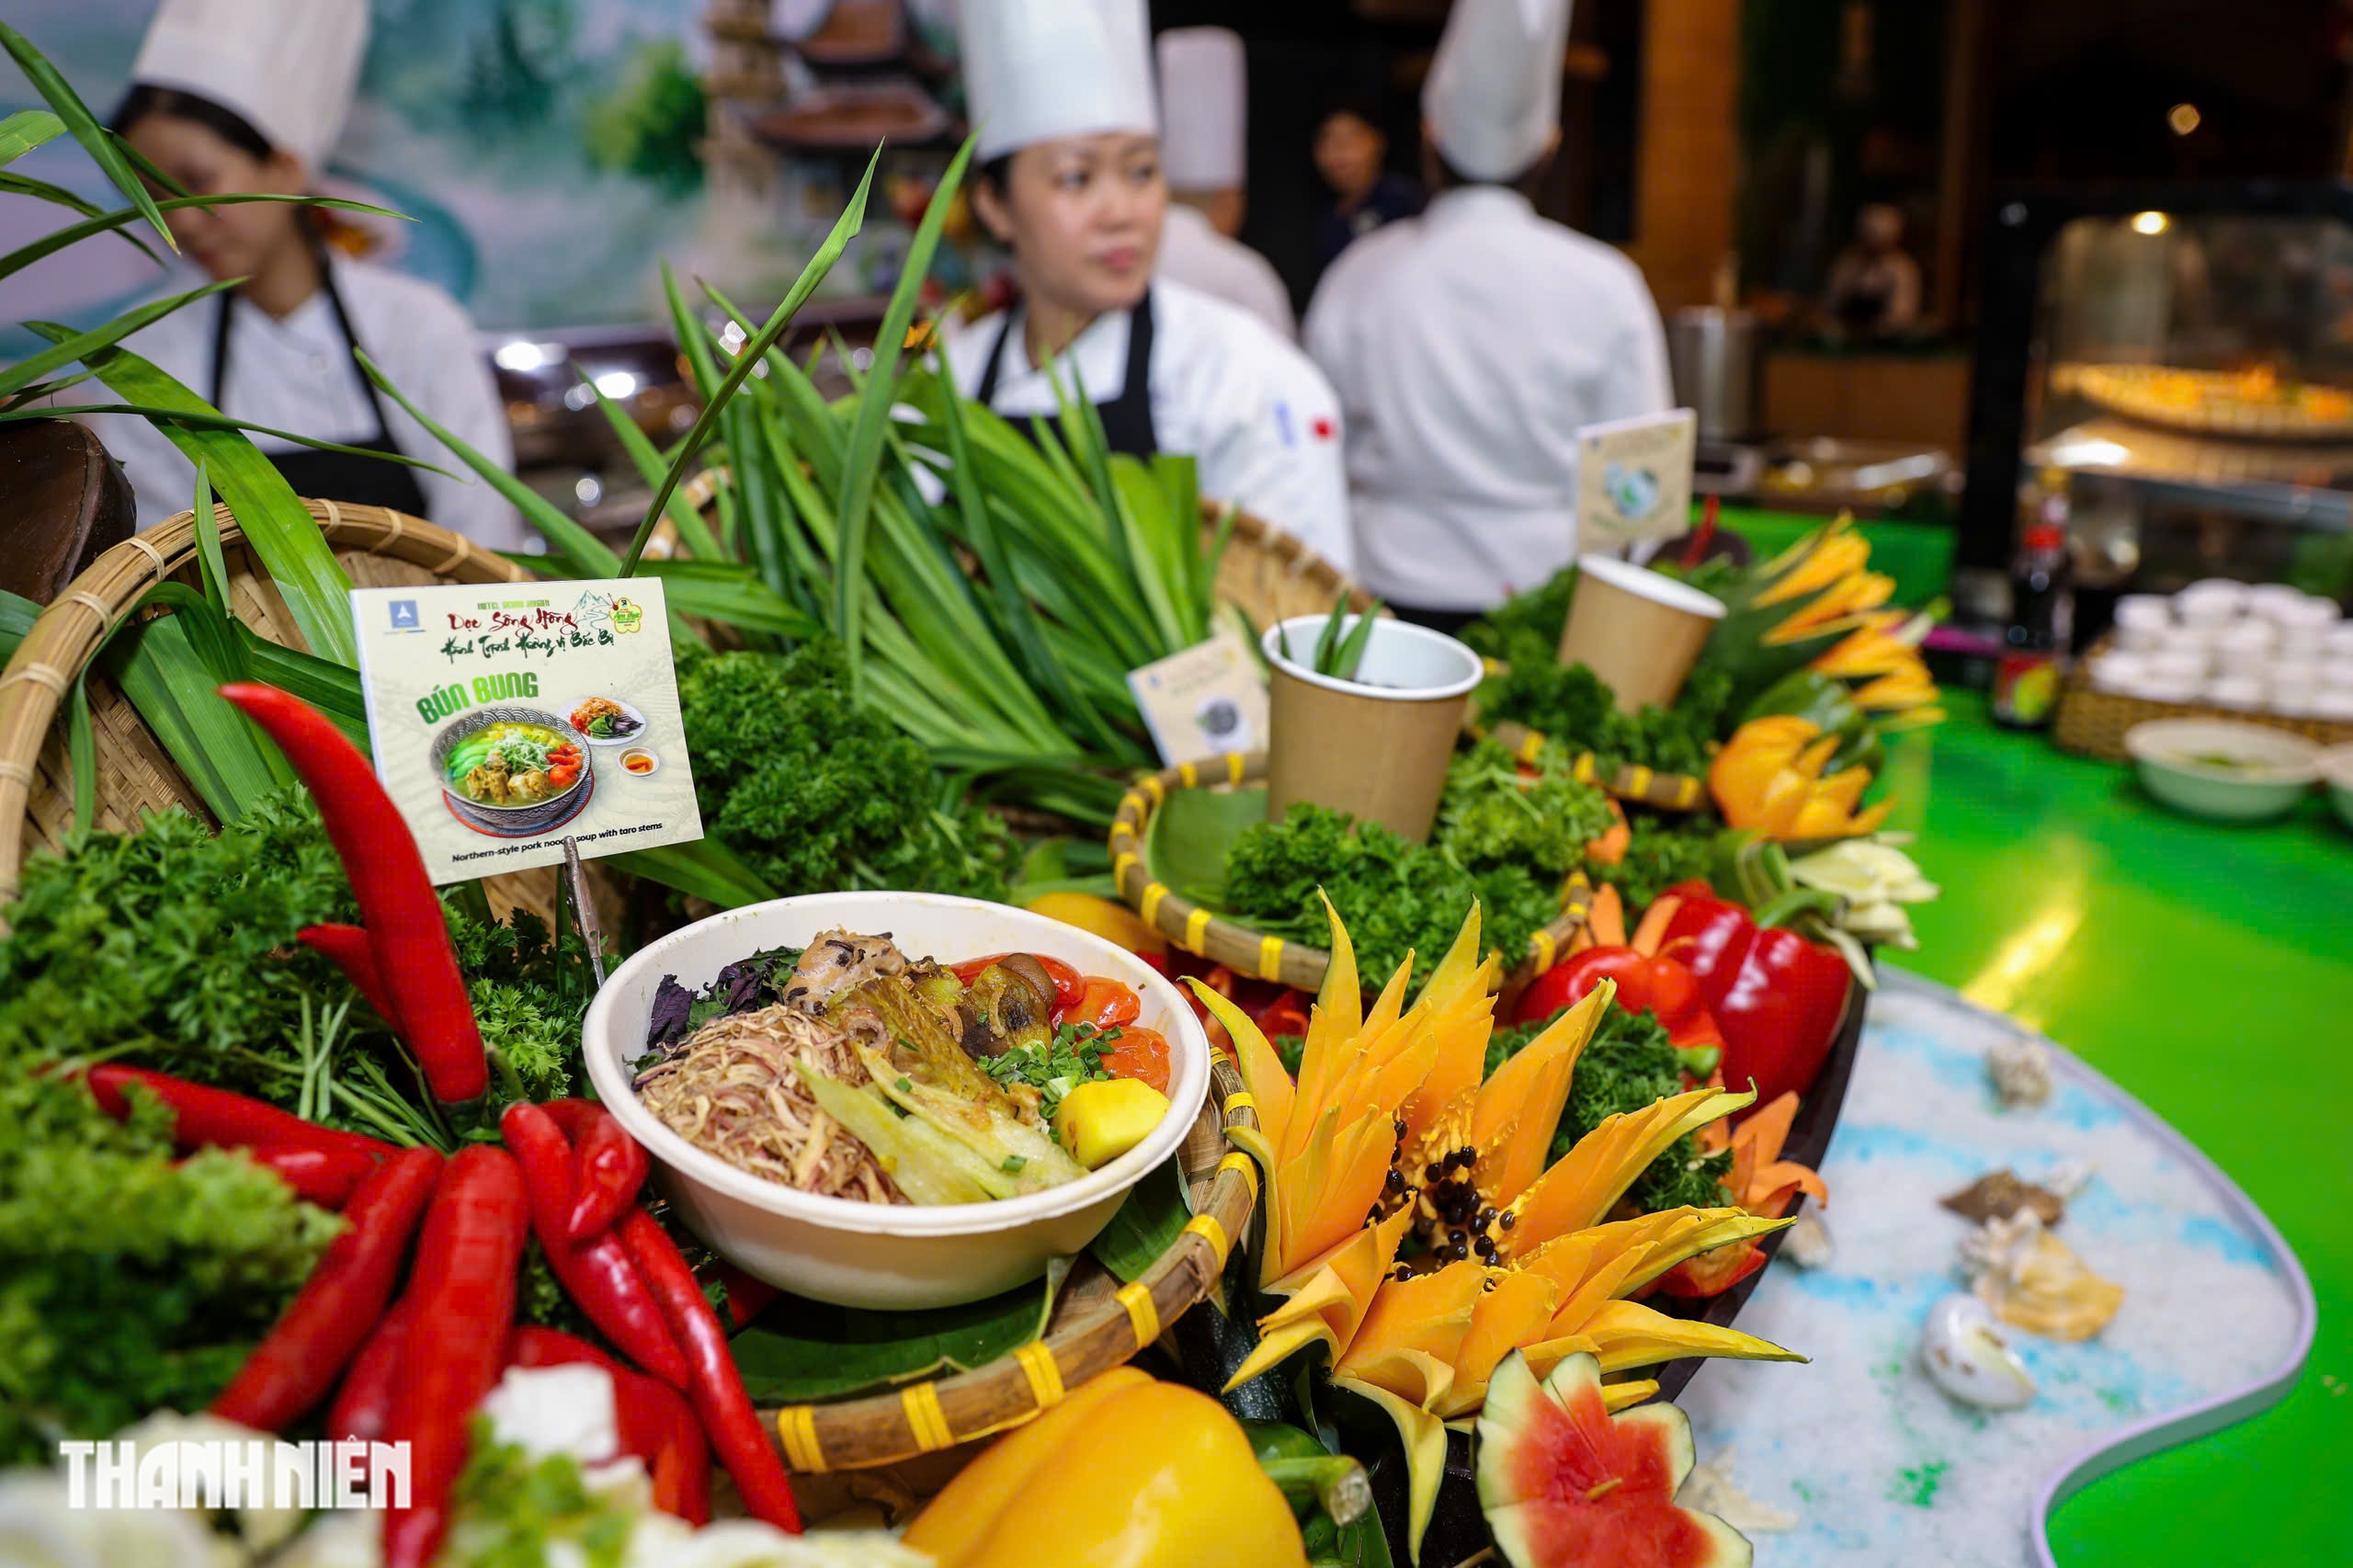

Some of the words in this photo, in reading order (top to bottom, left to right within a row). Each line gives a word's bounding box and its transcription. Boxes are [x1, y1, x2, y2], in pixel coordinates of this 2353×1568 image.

[488, 611, 534, 638] Sông
[536, 608, 578, 635] Hồng
[415, 684, 471, 724] BÚN
[472, 672, 540, 704] BUNG
[452, 845, 519, 862] Northern-style
[521, 840, 541, 853] pork
[544, 838, 566, 847] noo
[575, 833, 597, 843] soup
[598, 829, 618, 839] with
[619, 826, 637, 835] taro
[638, 822, 663, 833] stems
